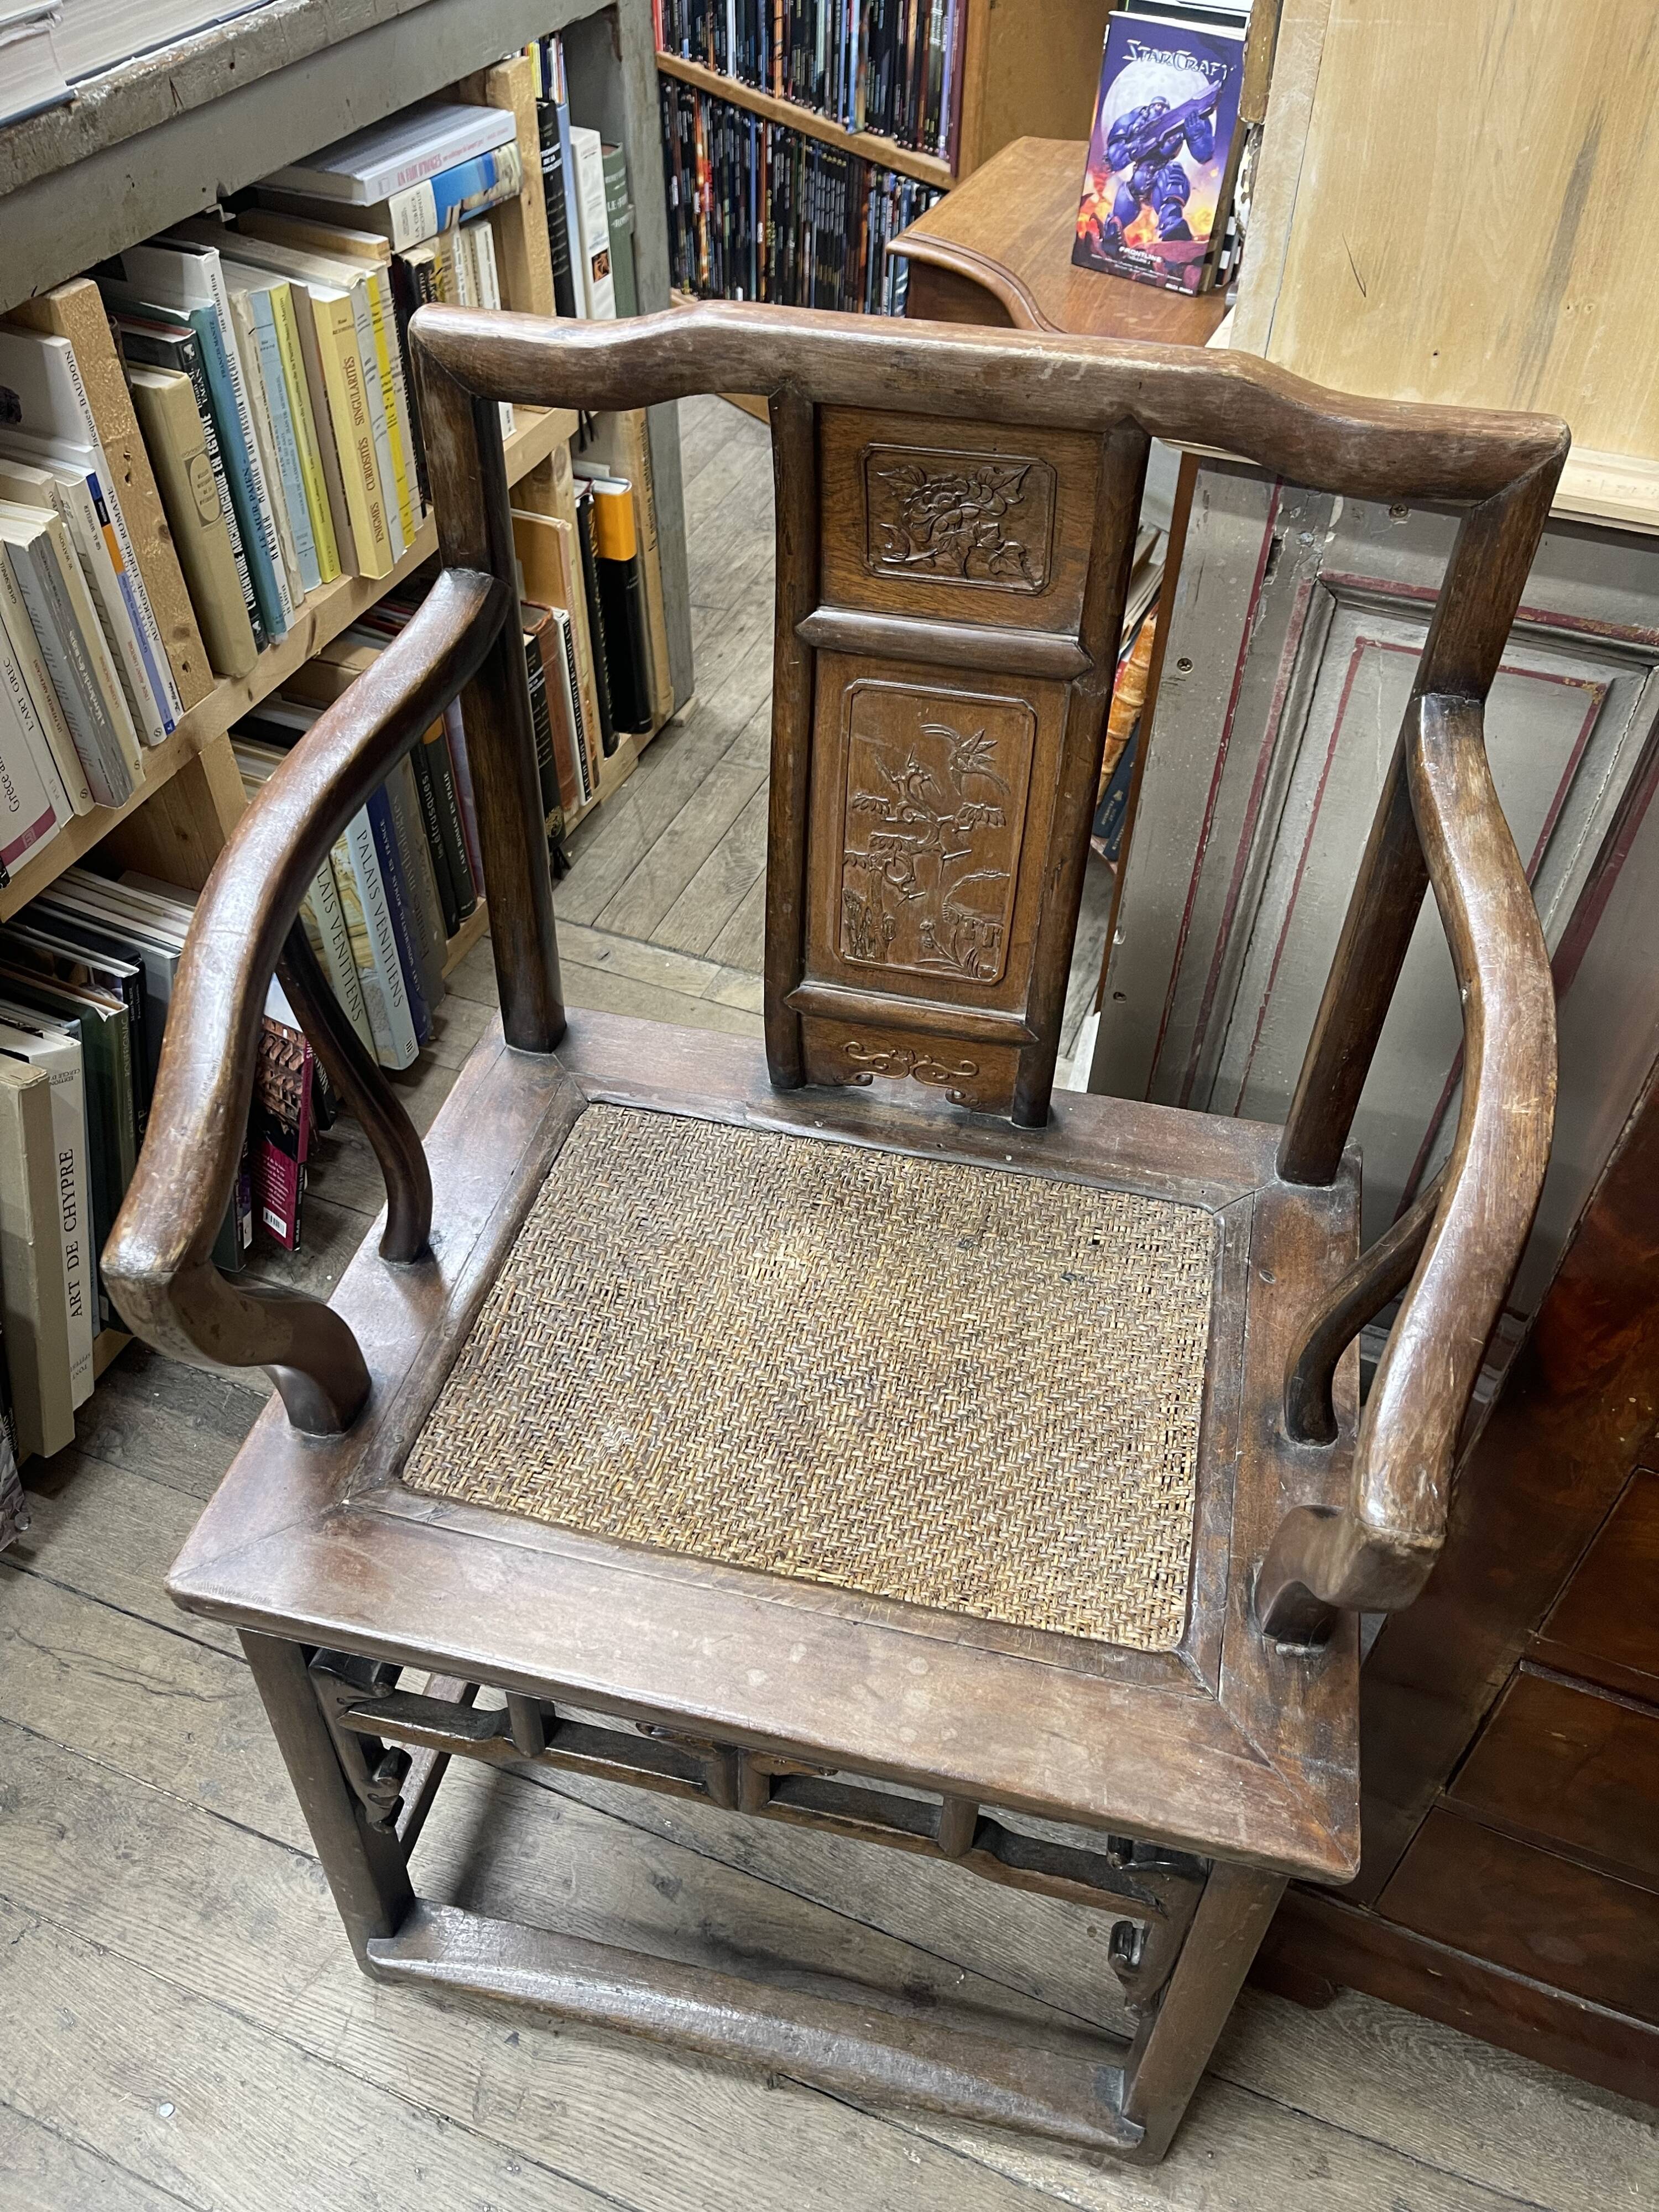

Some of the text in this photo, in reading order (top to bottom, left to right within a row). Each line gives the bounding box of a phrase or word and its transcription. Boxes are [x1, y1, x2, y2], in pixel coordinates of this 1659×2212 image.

[1118, 244, 1162, 263] FRONTLINE
[64, 349, 100, 448] Jacques BAUDOIN
[343, 356, 365, 426] SINGULARITÉS
[200, 413, 220, 456] EGYPTE
[237, 401, 251, 436] PASSION
[210, 456, 224, 473] EN
[358, 437, 376, 491] CURIOSITÉS
[83, 503, 97, 532] WHEELER
[213, 472, 243, 554] ARCHEOLOGIQUE
[251, 504, 264, 531] MUR
[643, 495, 656, 535] peinture
[57, 531, 71, 562] WATSON
[258, 534, 267, 549] LE
[262, 514, 279, 560] ANGKOR
[647, 538, 658, 551] la
[106, 486, 160, 642] AUVERGNE TERRE ROMANE
[234, 553, 257, 610] L'AVENTURE
[1, 656, 36, 731] L'ART GREC
[44, 694, 60, 723] PREMIERS
[55, 722, 63, 733] LES
[0, 773, 21, 813] Grèce
[442, 770, 453, 800] ITALIE
[421, 774, 441, 844] étrusques
[448, 801, 456, 814] EN
[379, 818, 392, 855] FRANCE
[451, 816, 463, 847] ROMAN
[356, 829, 381, 900] PALAIS
[387, 858, 395, 872] EN
[392, 795, 430, 960] Femmes mythologies
[317, 868, 337, 915] LAIS
[390, 875, 403, 907] ROMAN
[398, 909, 416, 967] MONUMENTAL
[121, 1016, 132, 1077] ROUFFIGNAC
[59, 1148, 82, 1318] ART DE CHYPRE
